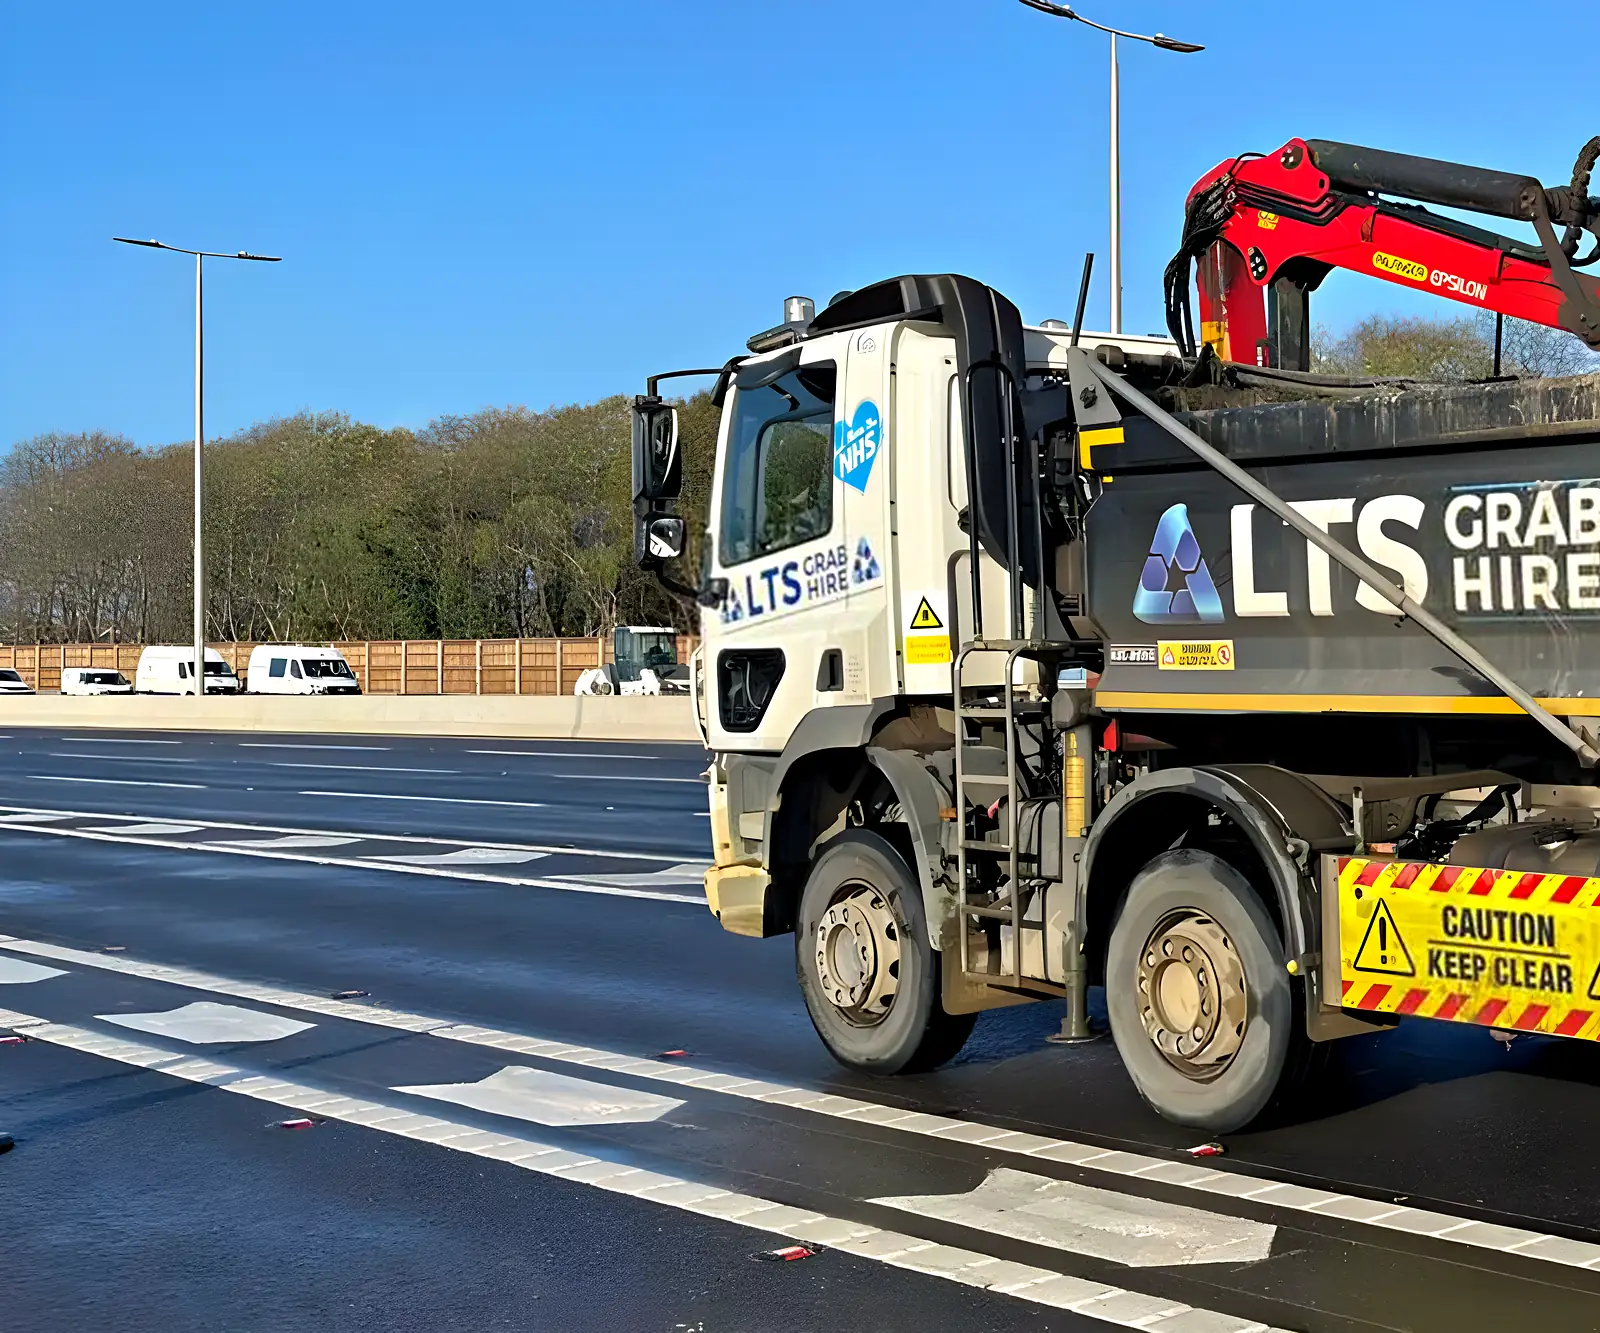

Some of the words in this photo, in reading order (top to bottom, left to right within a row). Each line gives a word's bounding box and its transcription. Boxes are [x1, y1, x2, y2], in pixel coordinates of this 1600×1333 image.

[839, 429, 876, 479] NHS
[803, 545, 848, 577] GRAB
[1230, 494, 1429, 617] LTS
[746, 561, 802, 617] LTS
[806, 568, 849, 600] HIRE
[1442, 905, 1555, 947] CAUTION
[1428, 949, 1486, 981] KEEP
[1494, 957, 1573, 993] CLEAR
